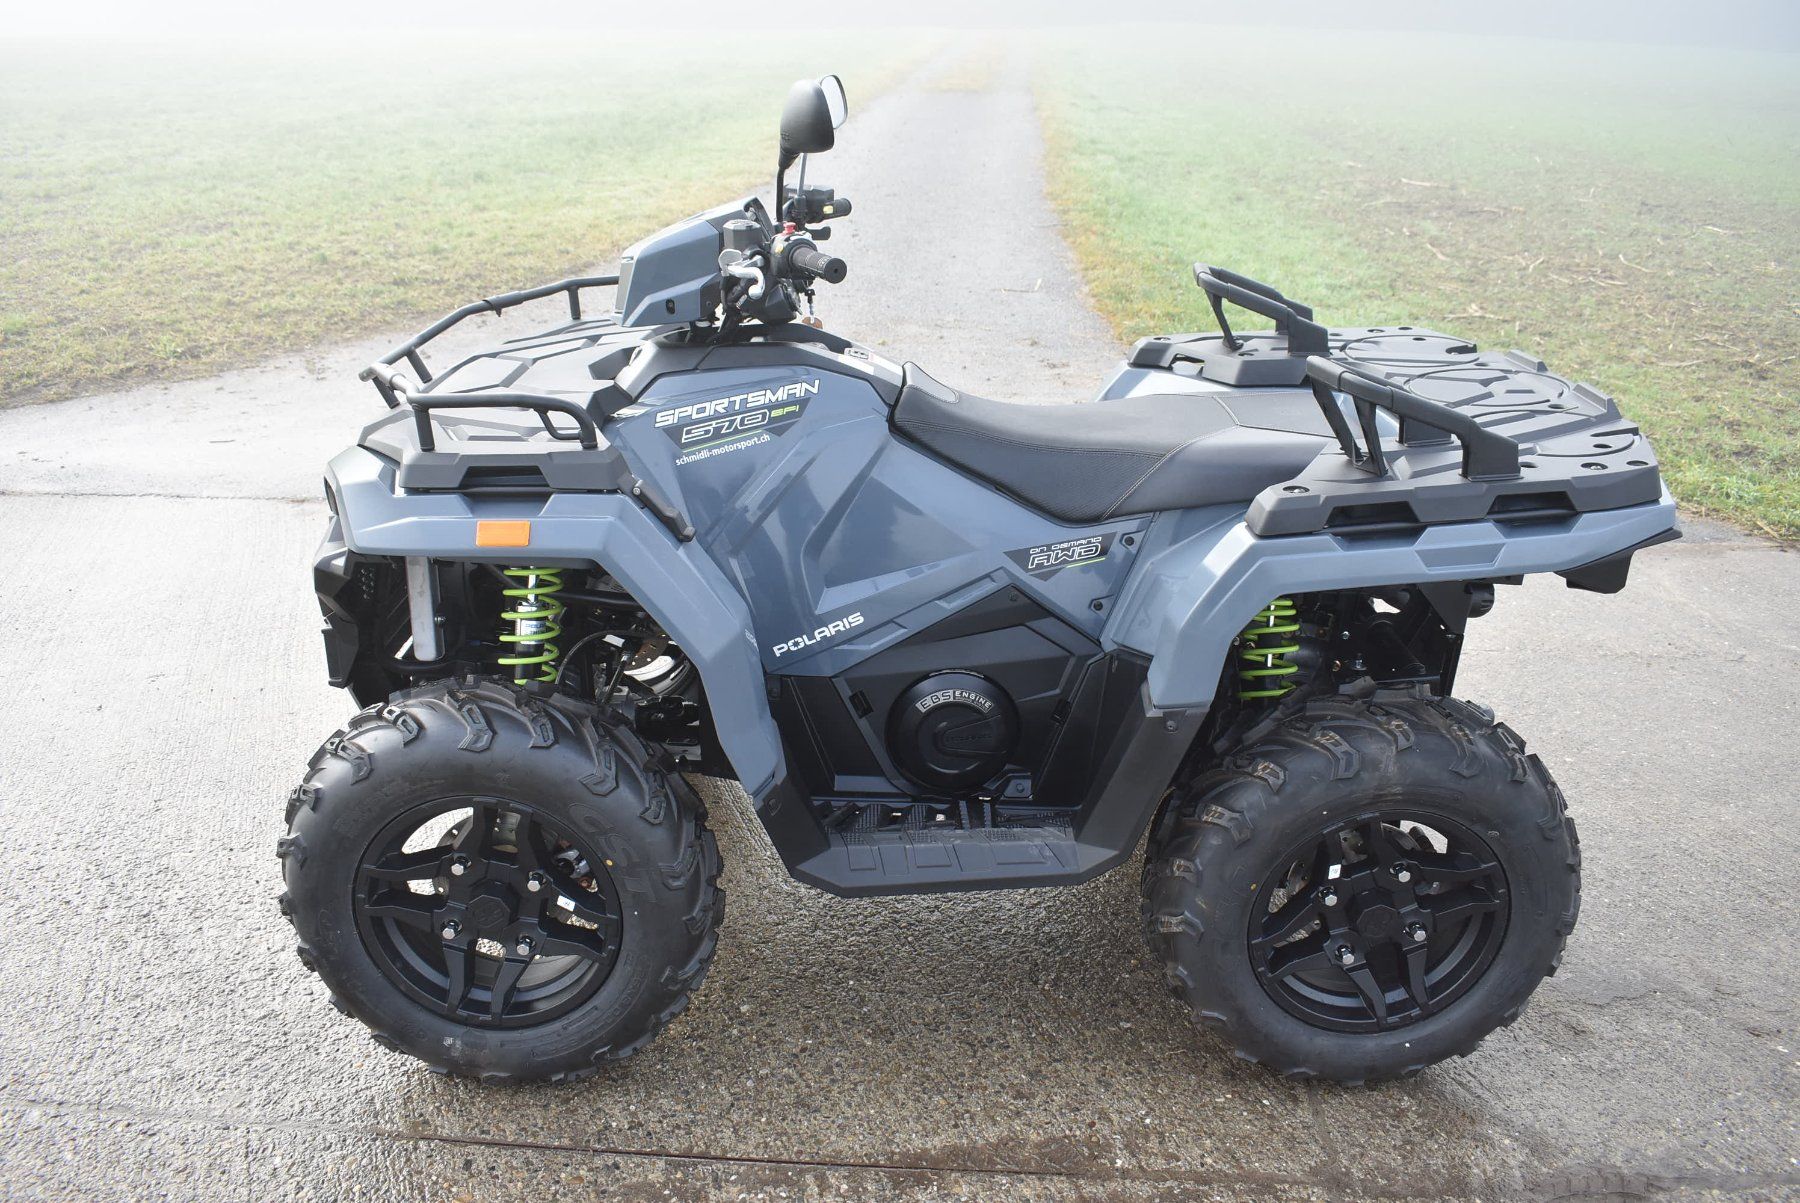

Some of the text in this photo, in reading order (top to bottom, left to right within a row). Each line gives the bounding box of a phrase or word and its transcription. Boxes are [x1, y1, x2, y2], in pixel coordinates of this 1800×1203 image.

[654, 379, 820, 428] SPORTSMAN
[681, 409, 770, 443] 570
[675, 434, 771, 466] schmidli-motorsport.ch
[1028, 542, 1101, 569] AWD
[1051, 536, 1102, 550] DEMAND
[772, 611, 865, 658] POLARIS
[920, 691, 952, 710] EBS
[955, 690, 992, 709] ENGINE
